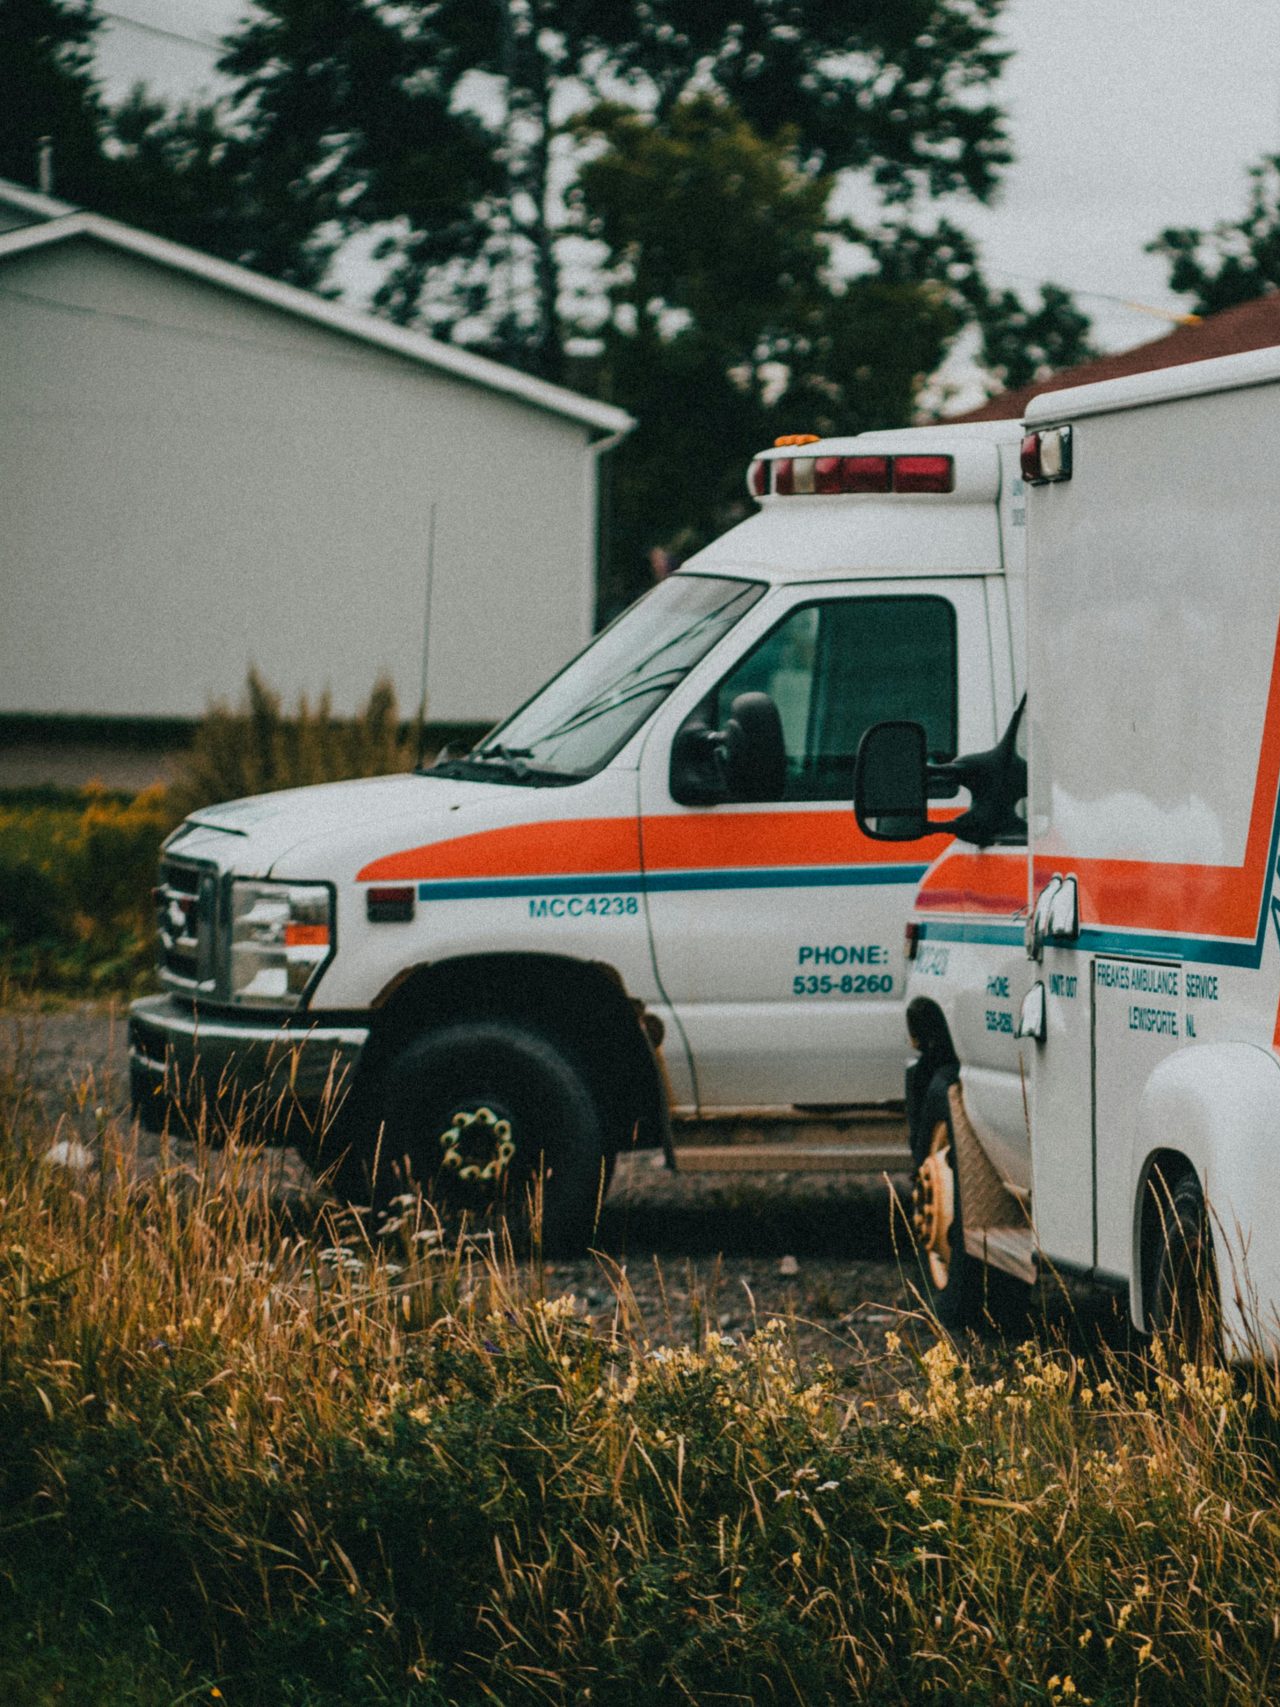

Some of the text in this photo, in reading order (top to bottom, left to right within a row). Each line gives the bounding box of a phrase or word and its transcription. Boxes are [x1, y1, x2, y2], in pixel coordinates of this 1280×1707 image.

[529, 896, 639, 918] MCC4238
[799, 945, 889, 965] PHONE:
[793, 974, 893, 995] 535-8260
[1097, 963, 1219, 1000] FREAKES AMBULANCE SERVICE
